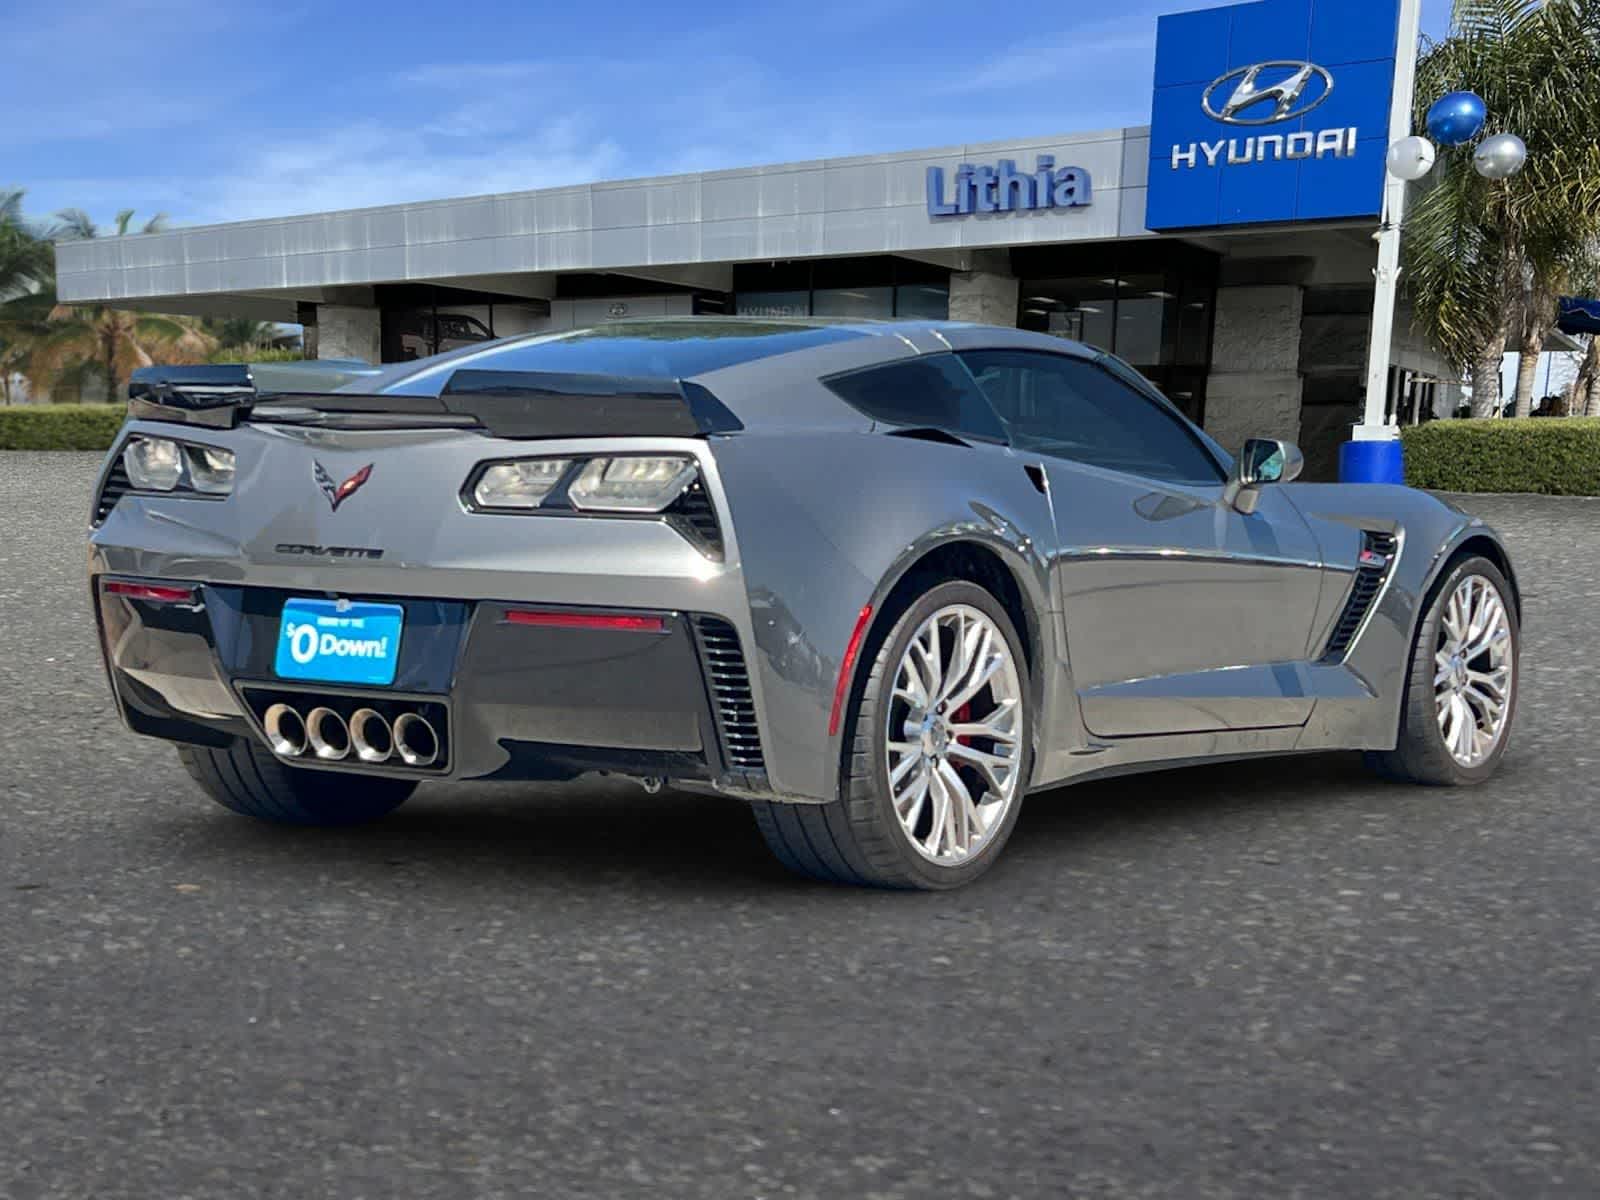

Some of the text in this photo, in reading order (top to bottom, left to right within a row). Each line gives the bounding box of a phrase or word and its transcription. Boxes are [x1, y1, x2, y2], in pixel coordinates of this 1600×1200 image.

[1171, 127, 1357, 169] HYUNDAI
[926, 155, 1092, 216] Lithia
[276, 544, 384, 559] CORVETTE
[320, 634, 387, 658] Down!
